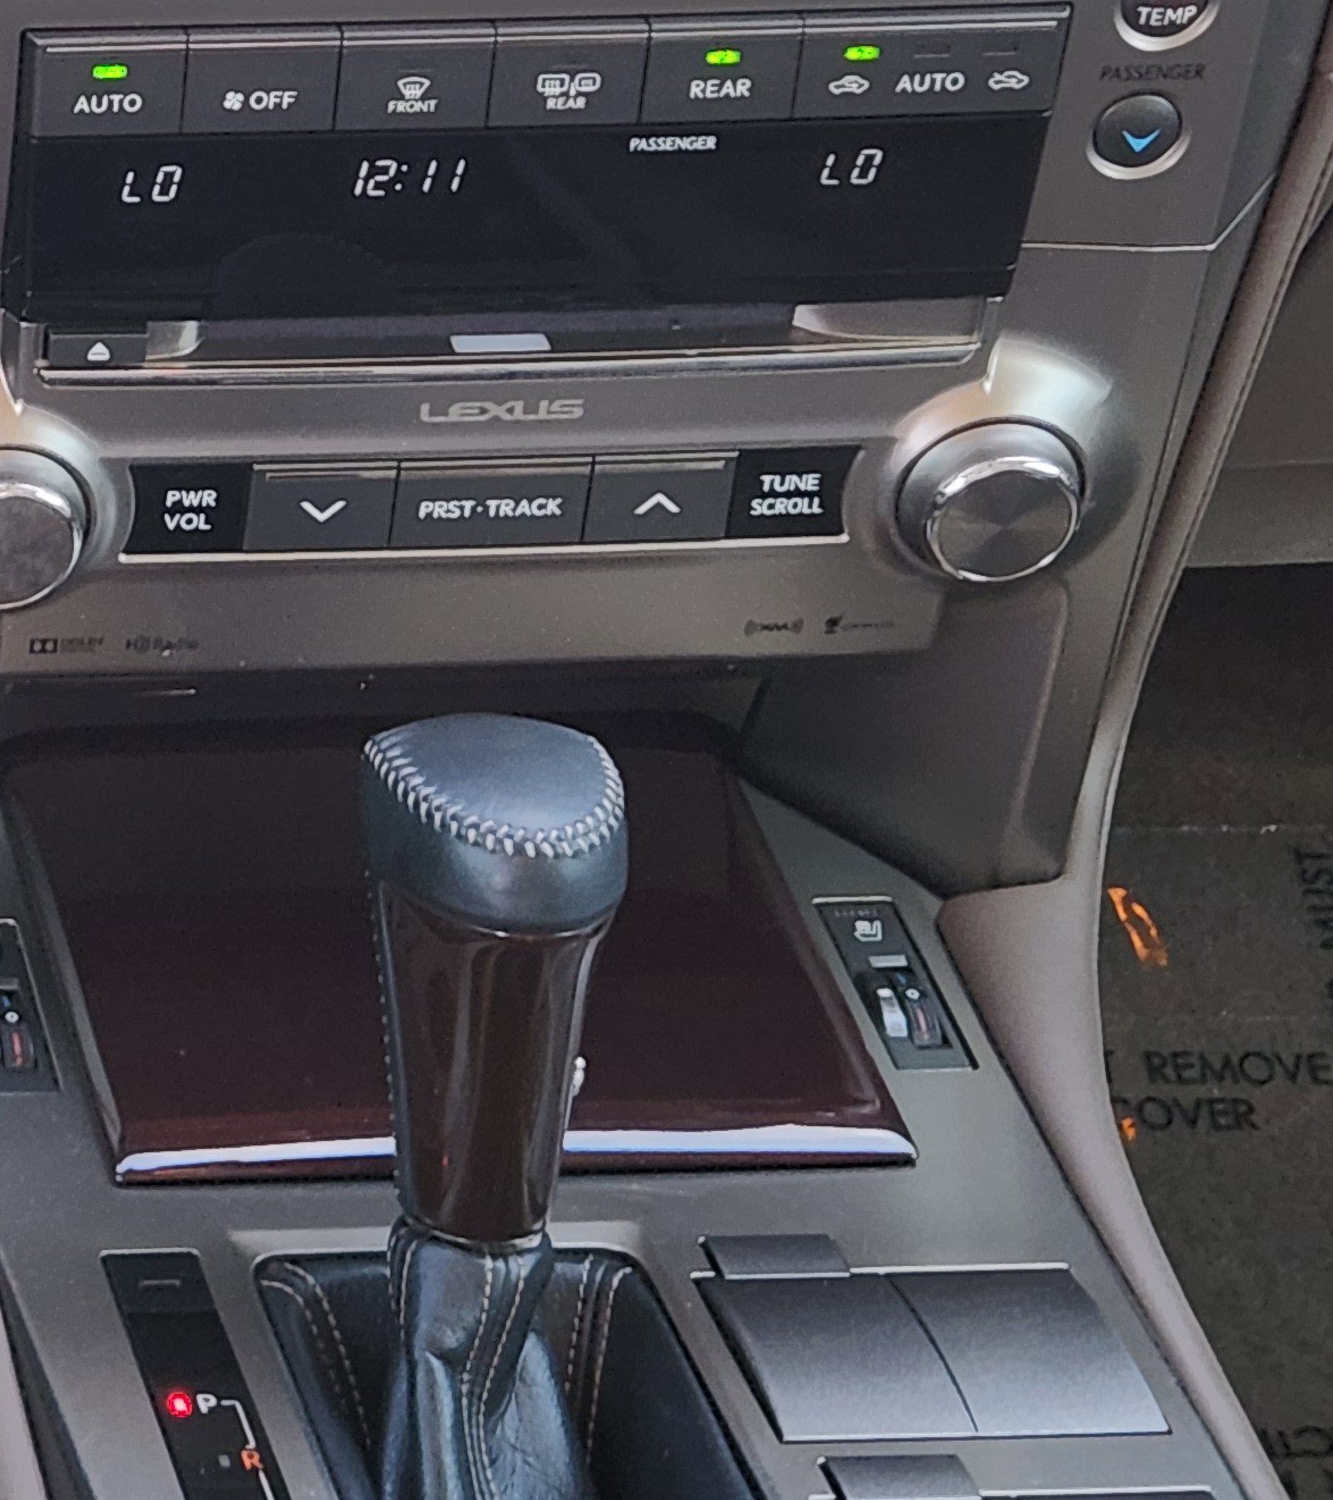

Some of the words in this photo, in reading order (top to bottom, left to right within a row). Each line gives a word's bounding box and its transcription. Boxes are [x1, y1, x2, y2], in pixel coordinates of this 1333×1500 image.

[1136, 4, 1197, 28] TEMP
[895, 71, 965, 94] AUTO
[1099, 63, 1207, 82] PASSENGER
[249, 89, 297, 110] OFF
[689, 78, 751, 100] REAR
[73, 92, 143, 114] AUTO
[387, 97, 438, 114] FRONT
[546, 97, 587, 111] REAR
[629, 134, 717, 152] PASSENGER
[353, 157, 467, 197] 12:11
[419, 398, 584, 424] LEXUS
[758, 472, 821, 497] TUNE
[165, 489, 218, 511] PWR
[749, 494, 823, 520] SCROLL
[163, 511, 212, 534] VOL
[195, 1393, 217, 1414] P
[240, 1449, 263, 1470] R
